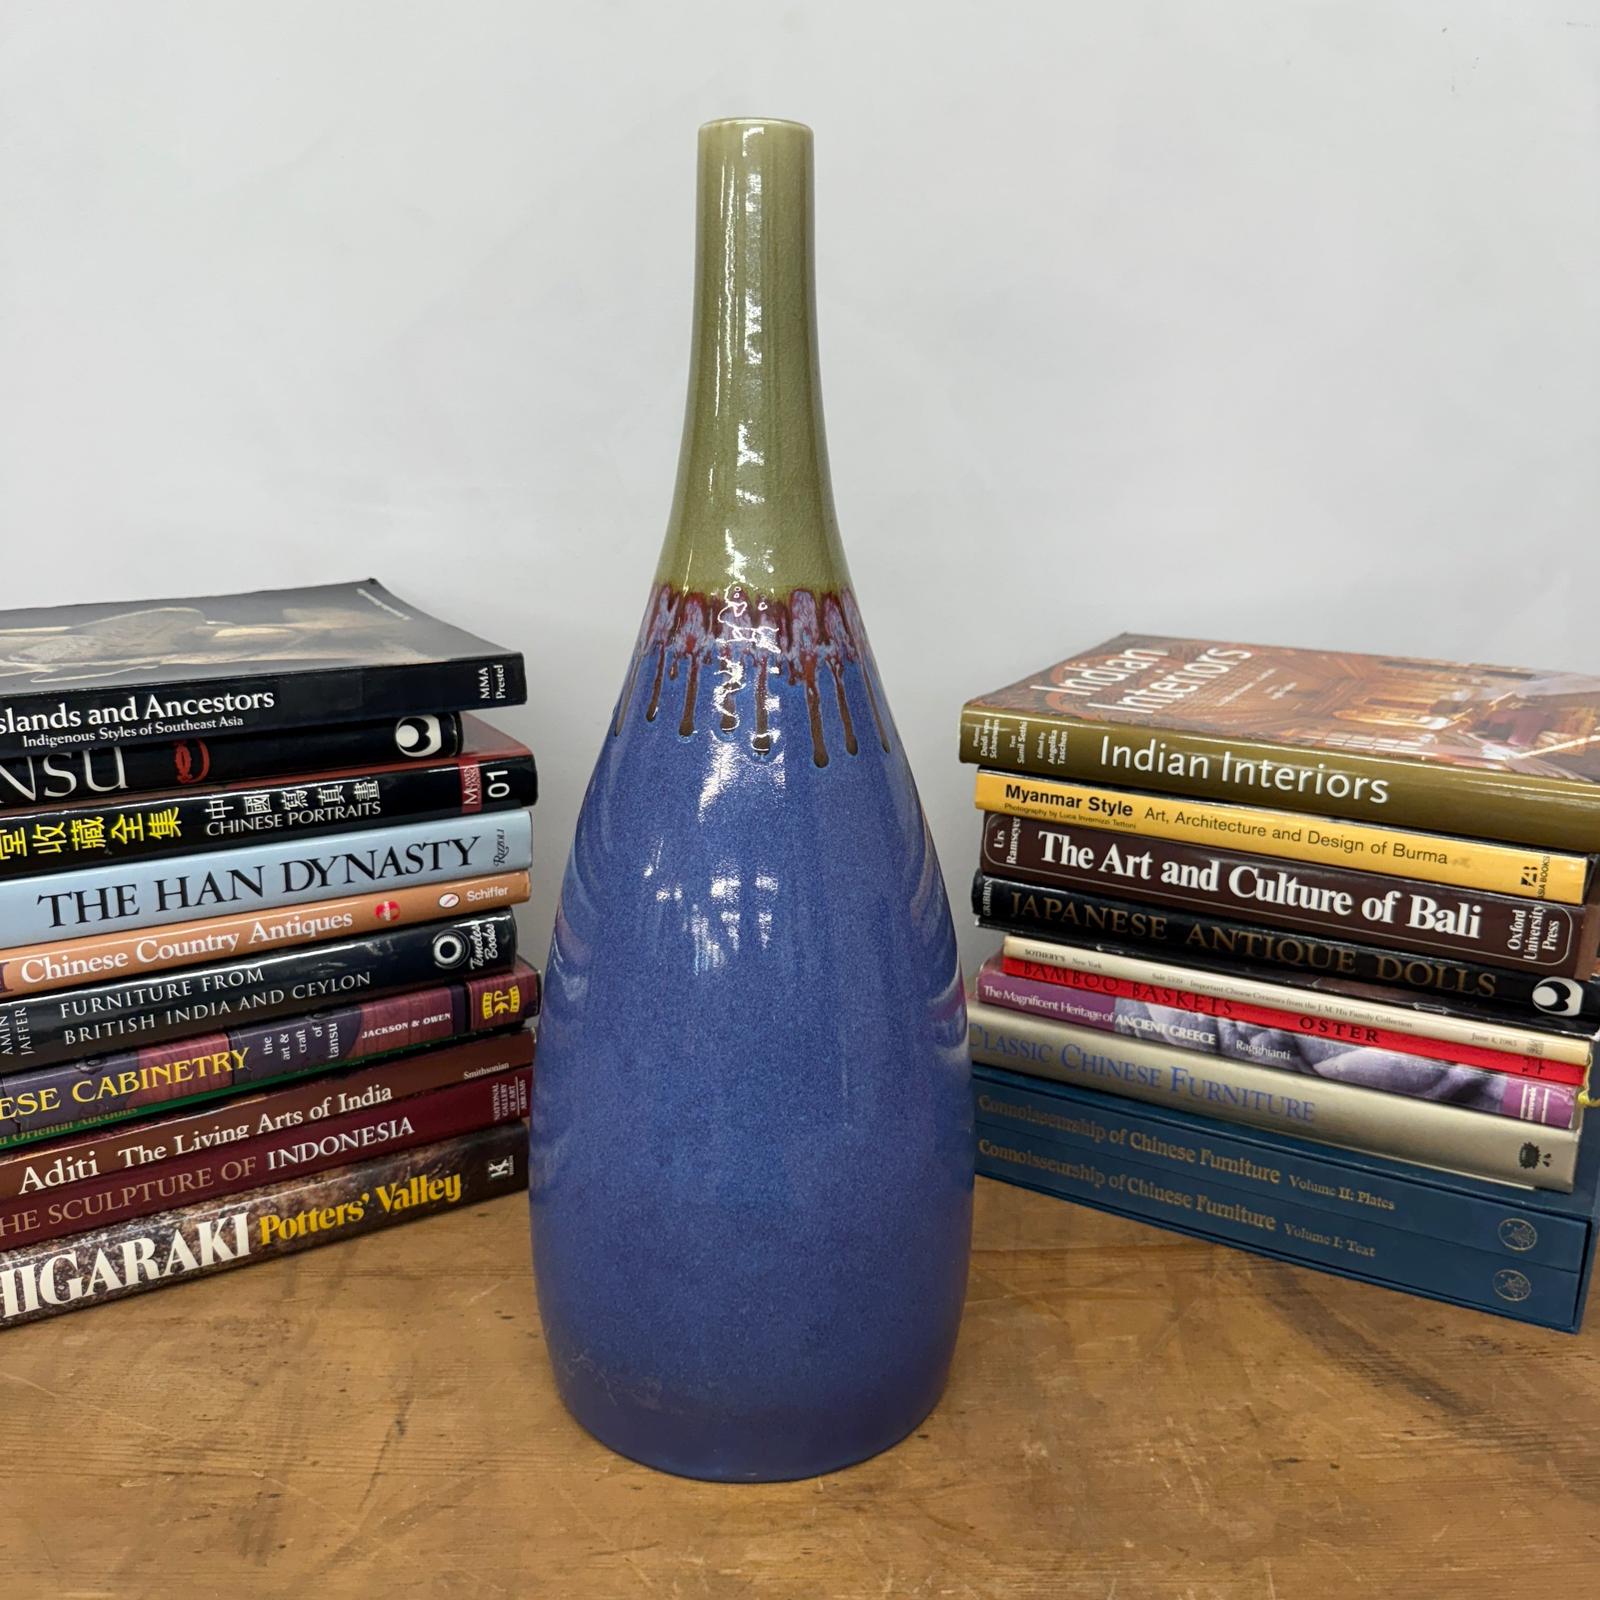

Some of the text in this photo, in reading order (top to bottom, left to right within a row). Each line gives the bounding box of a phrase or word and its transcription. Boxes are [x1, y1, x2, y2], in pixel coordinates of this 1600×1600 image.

[480, 667, 490, 699] MMA
[493, 664, 506, 700] Prestel
[1030, 648, 1169, 696] Indian
[1087, 647, 1253, 714] Interiors
[88, 696, 139, 726] and
[143, 691, 275, 720] Ancestors
[23, 716, 244, 748] Indigenous Styles of Southeast Asia
[1017, 721, 1028, 764] Sunil Sethi
[1047, 729, 1057, 765] Angelika
[1057, 731, 1068, 765] Taschen
[487, 770, 511, 799] 01
[1100, 736, 1390, 804] Indian Interiors
[206, 801, 381, 837] CHINESE PORTRAITS
[993, 829, 1005, 849] Urs
[1004, 803, 1048, 818] Photography
[1049, 809, 1058, 819] by
[1059, 811, 1076, 821] Luca
[1112, 818, 1137, 830] Tettoni
[1005, 783, 1448, 865] Myanmar Style Art, Architecture and Design of Burma
[1006, 816, 1021, 865] Ramseyer
[37, 836, 481, 928] THE HAN DYNASTY
[466, 887, 509, 902] Schiffer
[1038, 830, 1483, 939] The Art and Culture of Bali
[21, 953, 128, 984] Chinese
[136, 932, 240, 964] Country
[249, 911, 353, 944] Antiques
[1010, 891, 1497, 998] JAPANESE ANTIQUE DOLLS
[1507, 909, 1526, 951] Oxford
[1523, 904, 1546, 960] University
[1542, 920, 1560, 951] Press
[60, 967, 265, 1019] FURNITURE FROM
[64, 972, 371, 1045] BRITISH INDIA AND CEYLON
[1022, 960, 1379, 1044] BAMBOO BASKETS OSTER
[15, 1007, 37, 1056] JAFFER
[263, 1036, 273, 1055] the
[295, 1030, 307, 1054] craft
[311, 1025, 323, 1037] of
[361, 1012, 451, 1039] JACKSON & OWEN
[984, 985, 1291, 1061] The Magnificent Heritage of ANCIENT GREECE Ragghianti
[72, 1047, 250, 1103] CABINETRY
[281, 1046, 291, 1061] art
[463, 1062, 510, 1080] Smithsonian
[1060, 1043, 1162, 1089] CHINESE
[1170, 1066, 1316, 1124] FURNITURE
[18, 1084, 392, 1195] Aditi The Living Arts of India
[47, 1167, 214, 1226] SCULPTURE
[221, 1156, 257, 1180] OF
[267, 1117, 415, 1171] INDONESIA
[1109, 1129, 1127, 1145] of
[1130, 1131, 1196, 1164] Chinese
[1200, 1149, 1281, 1185] Furniture
[1288, 1174, 1335, 1197] Volume
[1357, 1191, 1396, 1211] Plates
[376, 1173, 462, 1213] Valley
[1109, 1174, 1127, 1191] of
[1127, 1176, 1192, 1209] Chinese
[1196, 1194, 1277, 1231] Furniture
[1284, 1223, 1332, 1245] Volume
[1346, 1240, 1376, 1258] Text
